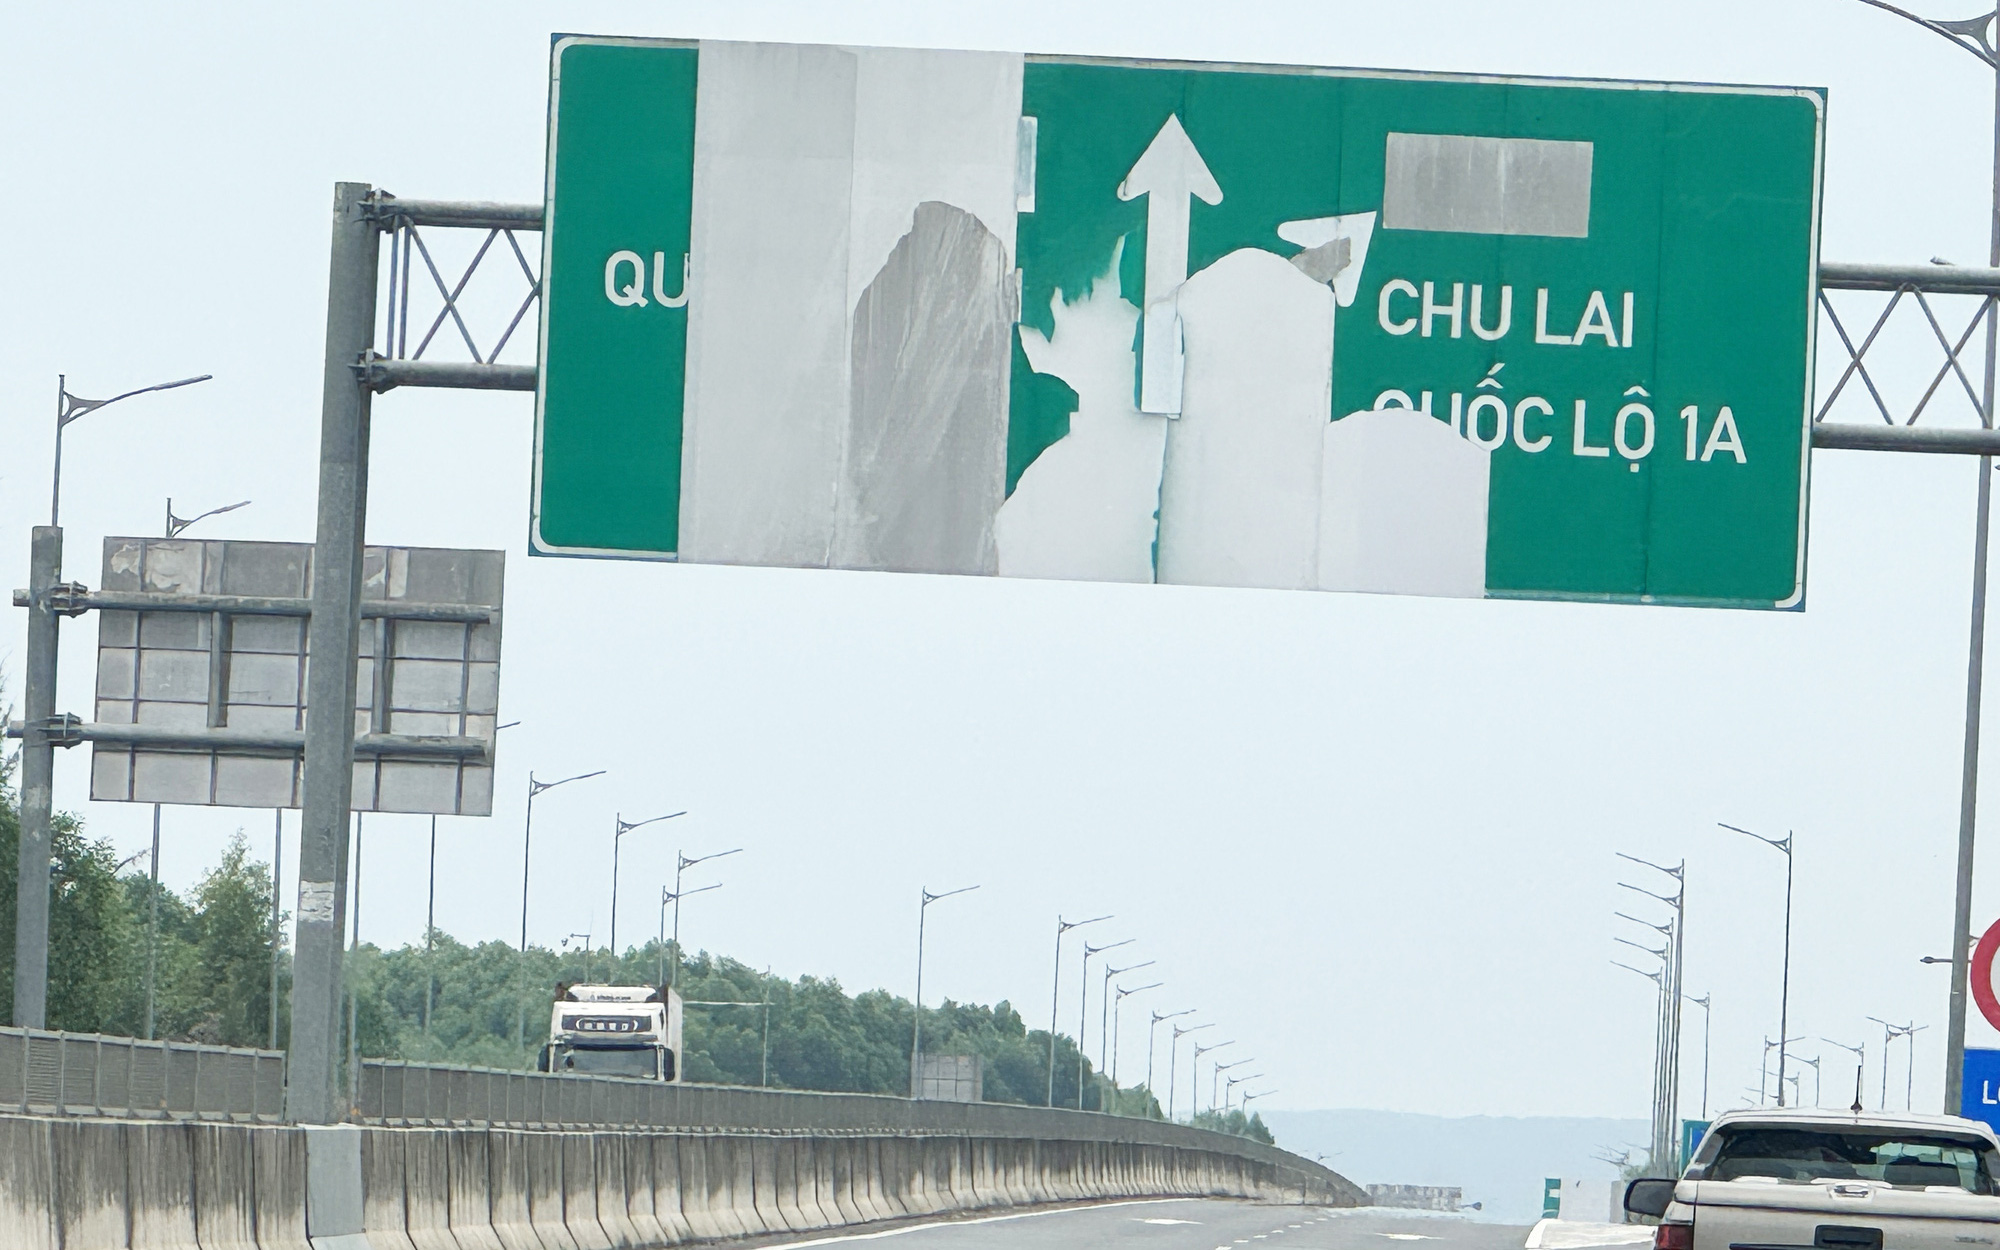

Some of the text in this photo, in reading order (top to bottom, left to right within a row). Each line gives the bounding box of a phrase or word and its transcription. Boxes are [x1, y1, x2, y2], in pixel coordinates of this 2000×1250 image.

[1377, 278, 1634, 347] CHU LAI
[1573, 385, 1656, 473] LỘ
[1679, 404, 1748, 464] 1A
[1982, 1080, 2000, 1104] L
